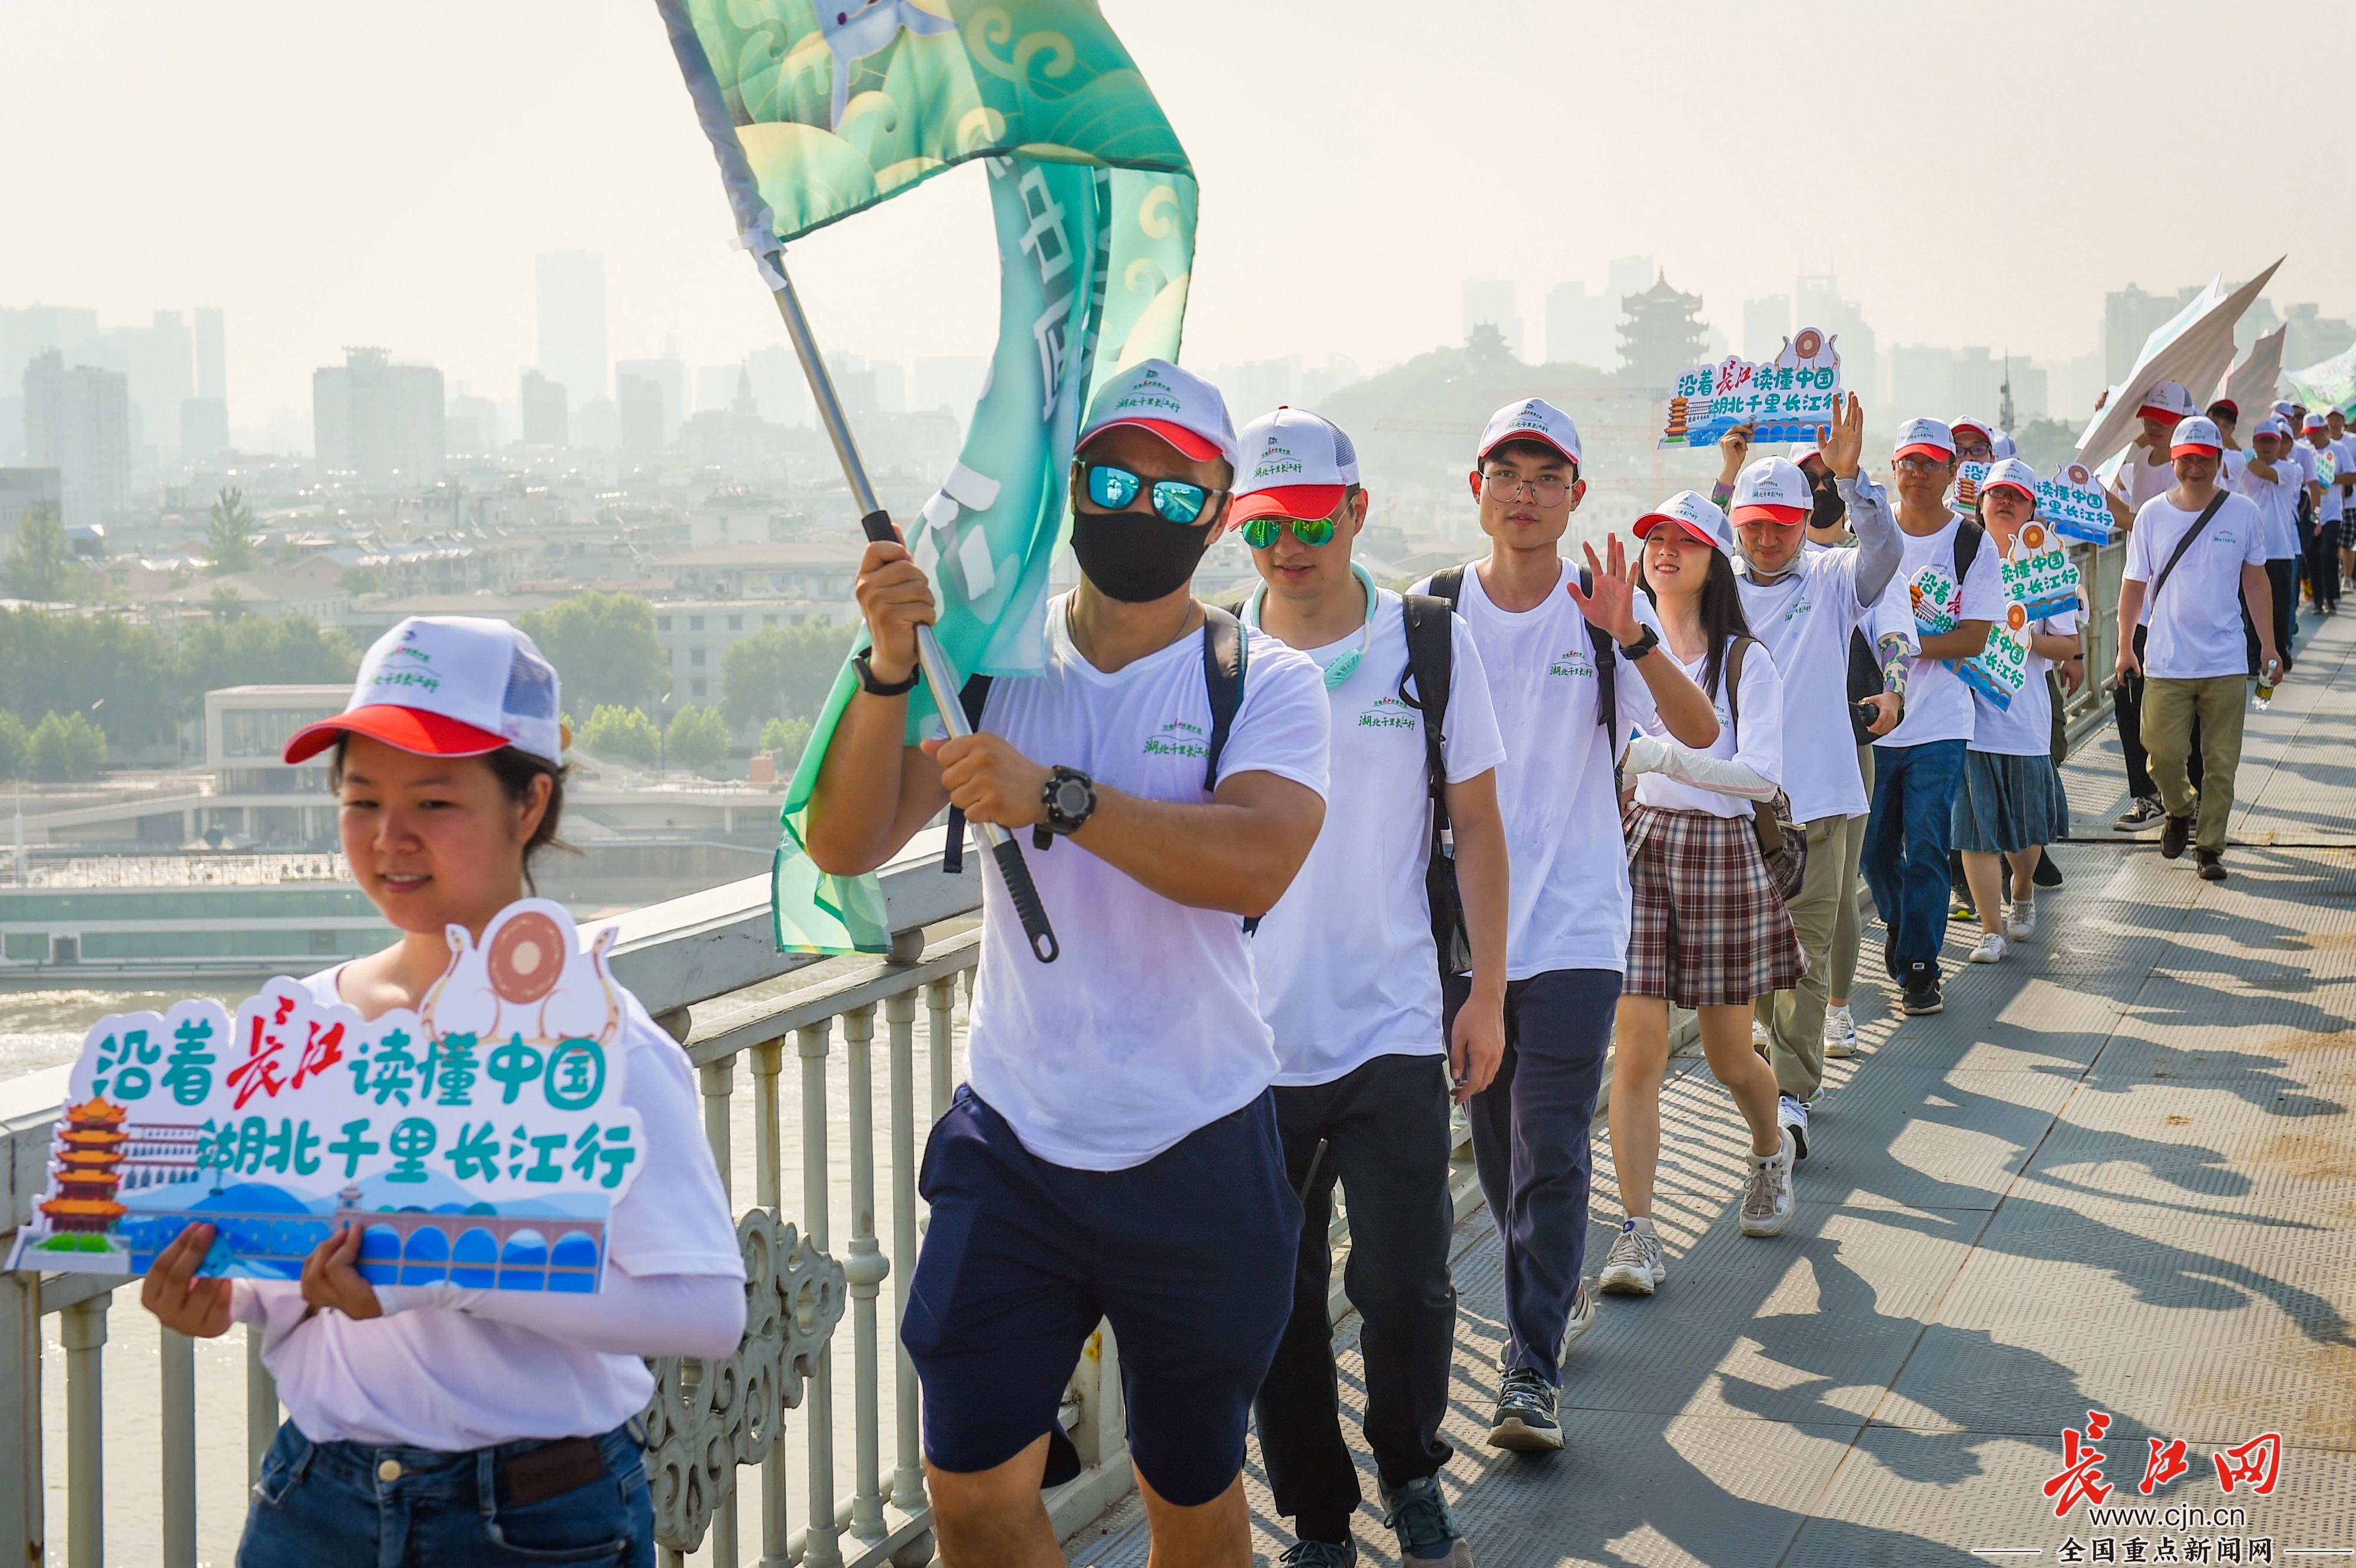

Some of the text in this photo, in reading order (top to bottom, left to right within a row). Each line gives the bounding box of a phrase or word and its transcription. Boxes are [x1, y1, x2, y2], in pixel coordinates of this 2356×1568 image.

[2004, 568, 2079, 601] 里长江行
[1976, 647, 2024, 689] 长江行
[197, 1116, 636, 1189] 湖北千里长江行
